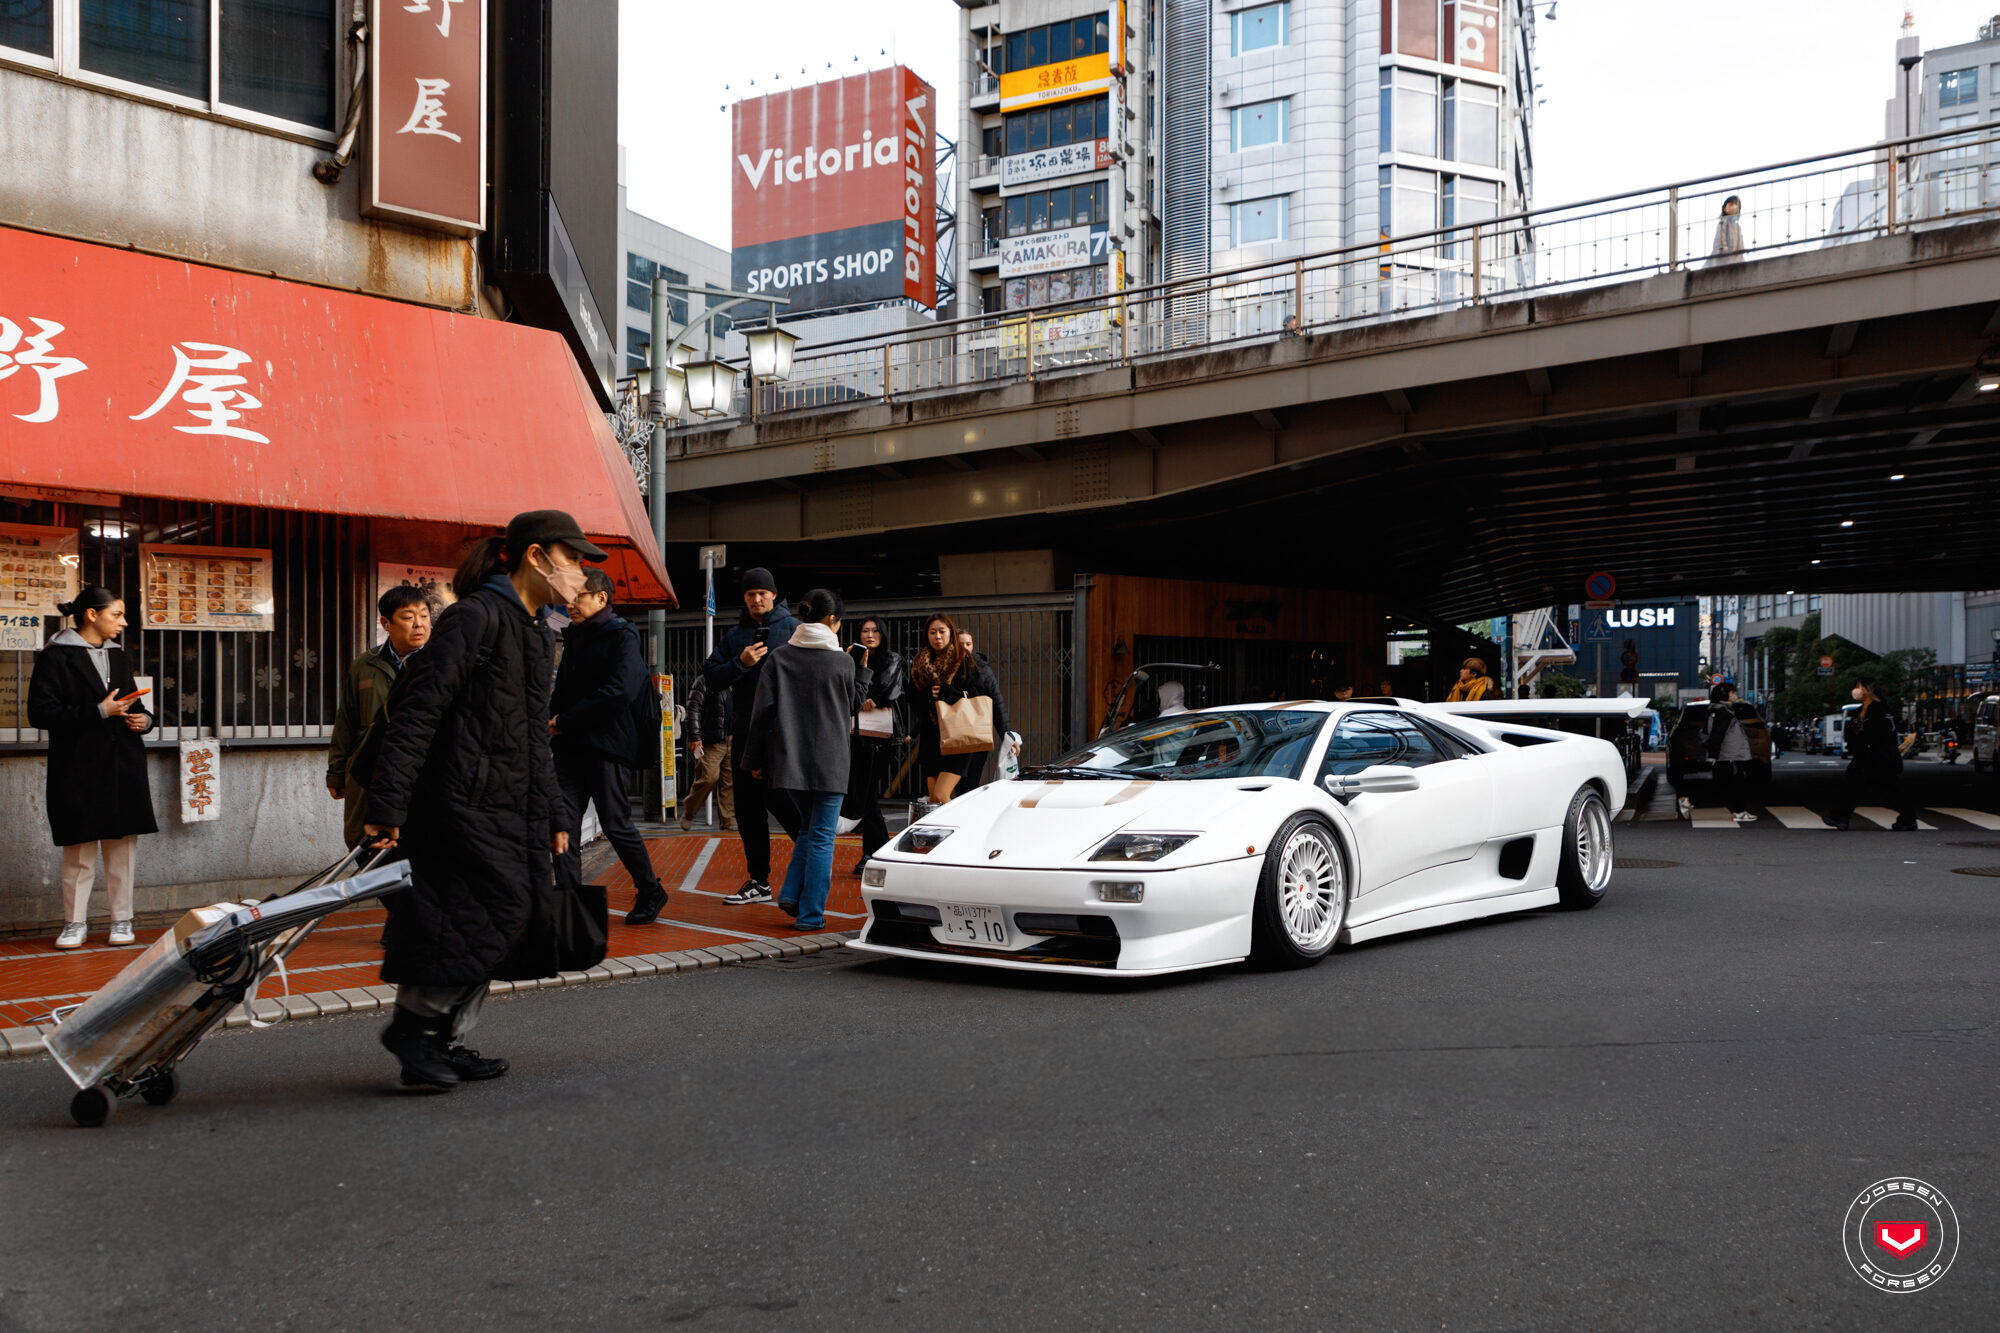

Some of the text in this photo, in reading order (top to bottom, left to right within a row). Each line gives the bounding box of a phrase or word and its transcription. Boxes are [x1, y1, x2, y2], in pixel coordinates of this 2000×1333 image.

[1460, 0, 1496, 63] ia
[737, 129, 899, 191] Victoria
[905, 94, 927, 284] Victoria
[747, 248, 894, 293] SPORTS SHOP
[1001, 240, 1089, 265] KAMAKURA
[1606, 607, 1675, 629] LUSH
[186, 748, 215, 815] 営業中
